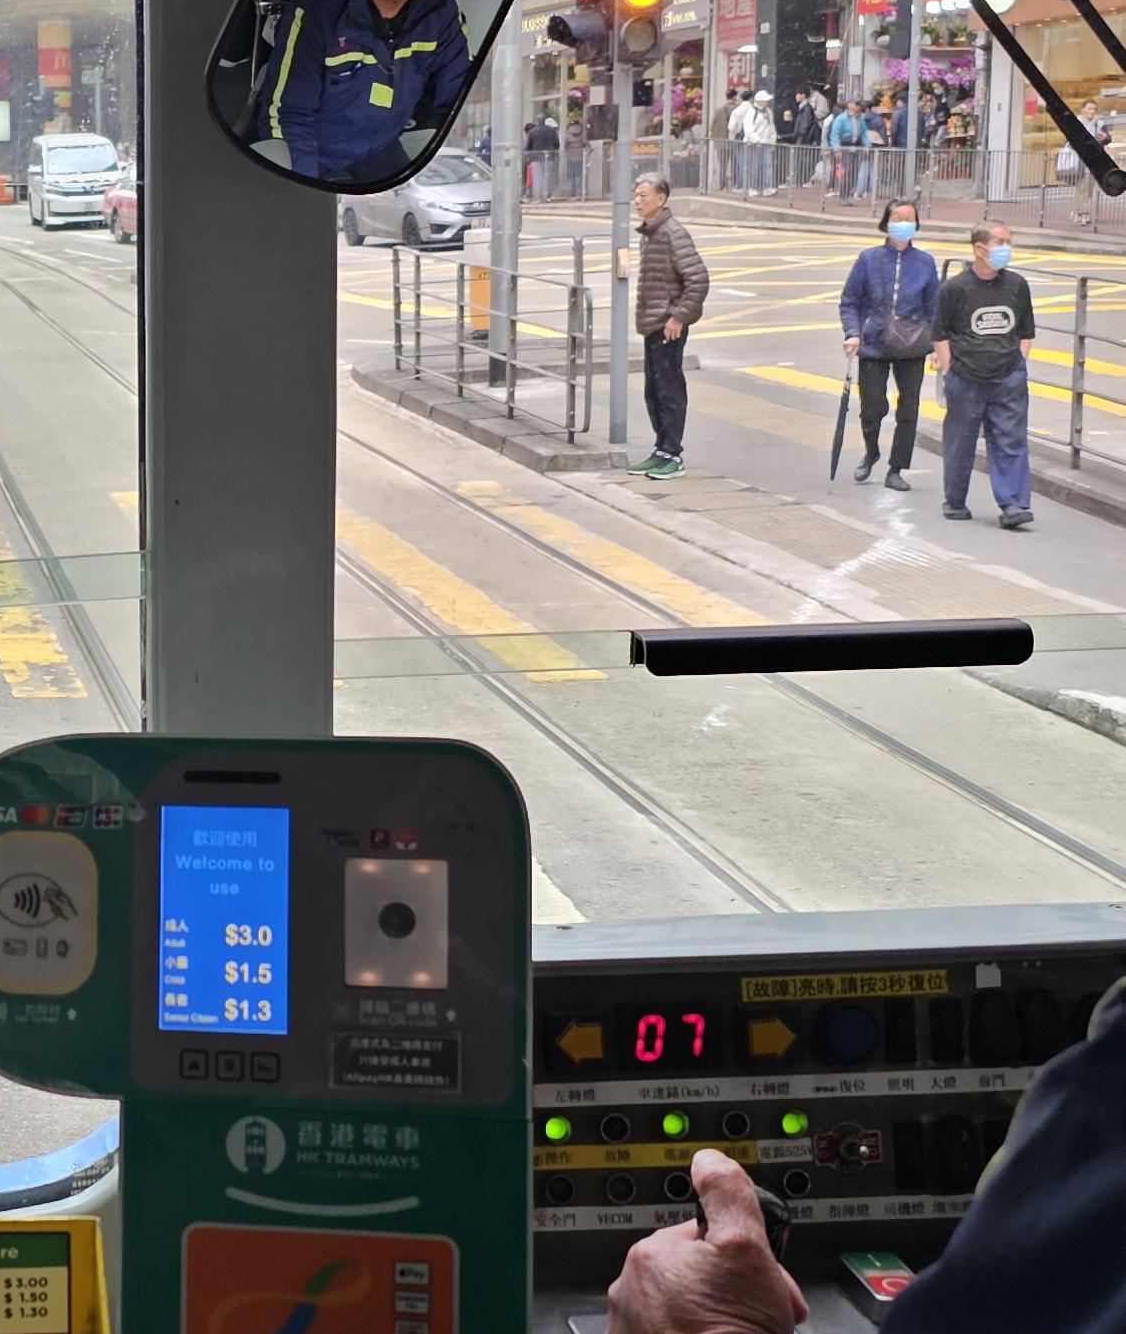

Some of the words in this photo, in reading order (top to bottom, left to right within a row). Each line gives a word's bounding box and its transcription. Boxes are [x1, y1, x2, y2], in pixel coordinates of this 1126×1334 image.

[192, 829, 258, 848] 歡迎使用
[176, 855, 253, 872] Welcome
[258, 856, 275, 872] to
[210, 883, 240, 895] use
[224, 923, 272, 947] $3.0
[224, 961, 272, 985] $1.5
[224, 998, 272, 1022] $1.3
[408, 1017, 437, 1028] code
[634, 1013, 706, 1063] 07
[887, 1078, 915, 1092] 照明
[978, 1074, 1006, 1088] 前門
[298, 1121, 419, 1150] 香港電車
[296, 1151, 319, 1164] HK
[325, 1151, 420, 1171] TRAMWAYS
[535, 1213, 576, 1228] 安全門
